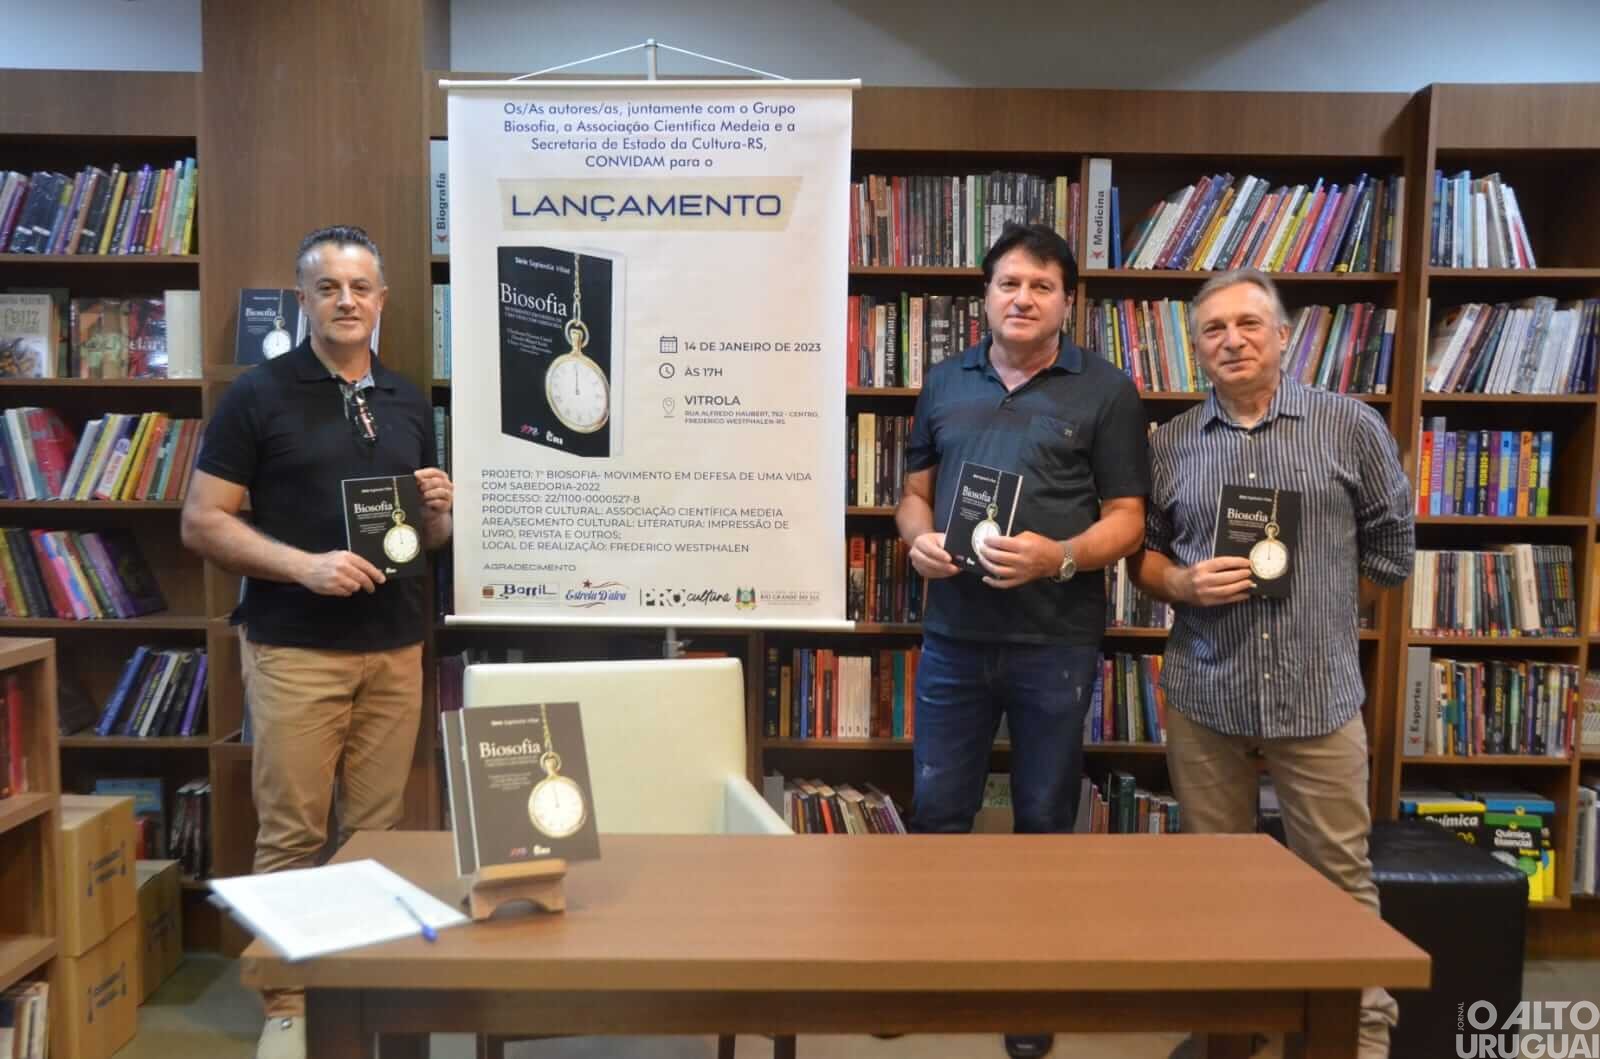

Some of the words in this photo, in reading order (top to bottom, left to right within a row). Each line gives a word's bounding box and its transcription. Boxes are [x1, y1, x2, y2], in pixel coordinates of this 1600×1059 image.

[503, 102, 545, 117] Os/As
[548, 102, 624, 118] autores/as,
[627, 101, 703, 118] juntamente
[707, 104, 735, 115] com
[739, 105, 749, 115] o
[752, 101, 796, 117] Grupo
[503, 119, 560, 135] Biosofia,
[563, 123, 573, 133] a
[576, 119, 650, 135] Associação
[653, 119, 716, 132] Científica
[719, 119, 770, 132] Medeia
[774, 122, 783, 132] e
[786, 122, 796, 132] a
[530, 137, 598, 150] Secretaria
[601, 137, 618, 150] de
[622, 137, 666, 150] Estado
[670, 137, 688, 150] da
[691, 136, 768, 152] Cultura-RS,
[585, 155, 665, 168] CONVIDAM
[669, 157, 700, 170] para
[704, 157, 713, 168] o
[435, 172, 448, 230] Biografia
[511, 194, 782, 222] LANÇAMENTO
[1092, 190, 1105, 246] Medicina
[499, 281, 568, 318] Biosofia
[684, 341, 697, 352] 14
[700, 342, 715, 352] DE
[719, 341, 772, 352] JANEIRO
[775, 342, 792, 352] DE
[793, 342, 822, 353] 2023
[703, 367, 723, 377] 17H
[684, 394, 741, 406] VITROLA
[684, 410, 700, 418] RUA
[701, 410, 735, 418] ALFREDO
[684, 417, 725, 425] FREDERICO
[547, 469, 601, 480] BIOSOFIA-
[603, 470, 672, 481] MOVIMENTO
[674, 471, 691, 481] EM
[694, 471, 737, 481] DEFESA
[739, 471, 754, 482] DE
[757, 472, 783, 482] UMA
[785, 472, 813, 482] VIDA
[481, 481, 507, 491] COM
[509, 481, 601, 492] SABEDORIA-2022
[353, 500, 394, 515] Biosofia
[481, 504, 543, 515] PRODUTOR
[605, 505, 676, 518] ASSOCIAÇÃO
[678, 506, 738, 518] CIENTÍFICA
[740, 507, 784, 518] MEDEIA
[1226, 507, 1269, 523] Biosofia
[707, 518, 772, 529] IMPRESSÃO
[774, 520, 789, 530] DE
[519, 529, 562, 540] REVISTA
[564, 530, 572, 540] E
[482, 541, 518, 551] LOCAL
[520, 541, 535, 551] DE
[610, 542, 672, 552] FREDERICO
[674, 543, 749, 553] WESTPHALEN
[482, 563, 577, 572] AGRADECIMENTO
[1409, 681, 1422, 733] Esportes
[478, 737, 542, 759] Biosofia
